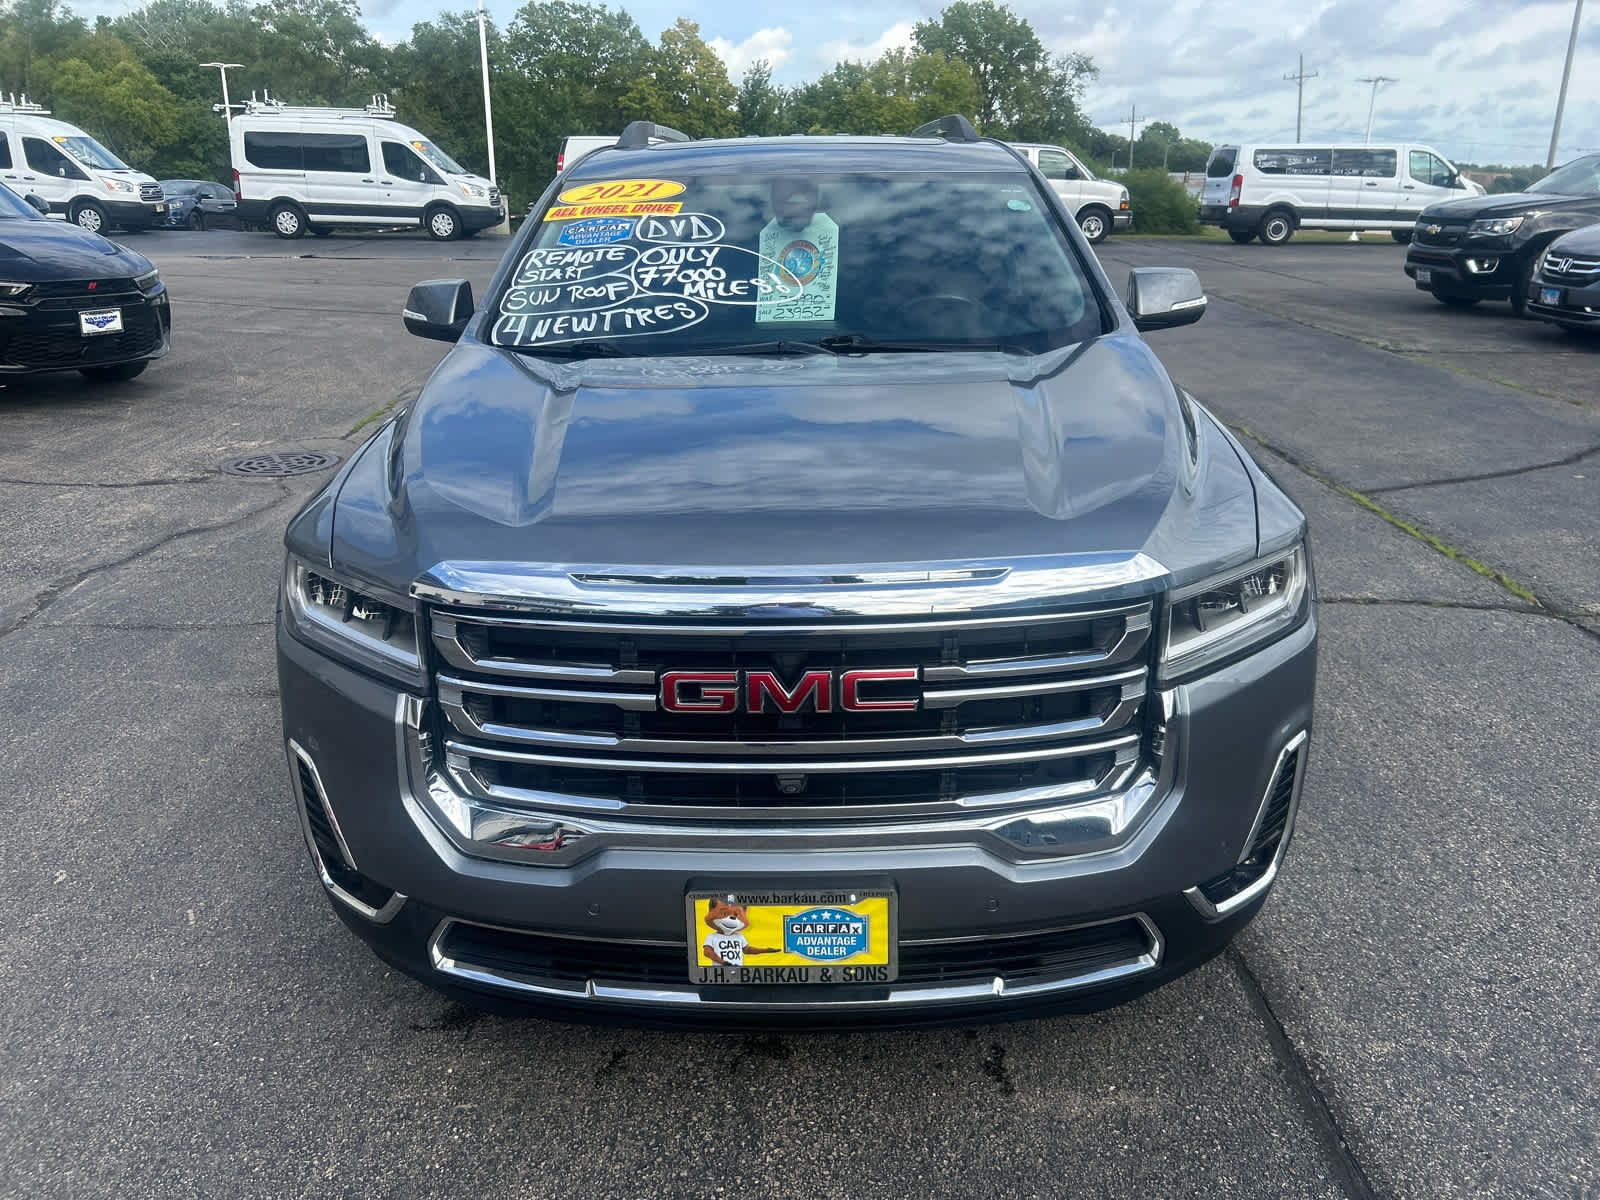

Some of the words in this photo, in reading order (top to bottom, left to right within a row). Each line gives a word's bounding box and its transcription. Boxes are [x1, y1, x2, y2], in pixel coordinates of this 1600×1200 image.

[576, 182, 665, 201] 2021
[550, 207, 577, 218] ALL
[580, 204, 629, 216] WHEEL
[631, 203, 677, 214] DRIVE
[647, 215, 713, 239] DVD
[568, 231, 621, 241] ADVANTAGE
[575, 237, 612, 246] DEALER
[525, 248, 628, 270] REMOTE
[641, 247, 721, 266] ONLY
[518, 265, 594, 283] START
[507, 288, 561, 310] SUN
[567, 282, 629, 303] ROOF
[503, 315, 528, 346] 4
[530, 313, 597, 341] NEW
[660, 668, 919, 713] GMC
[737, 892, 847, 906] www.barkau.com
[791, 923, 863, 935] CARFAX
[718, 940, 741, 950] CAR
[796, 936, 857, 947] ADVANTAGE
[720, 951, 741, 961] FOX
[807, 946, 847, 956] DEALER
[699, 968, 730, 984] J.H.
[740, 968, 809, 983] BARKAU
[820, 967, 832, 982] &
[843, 967, 888, 982] SONS
